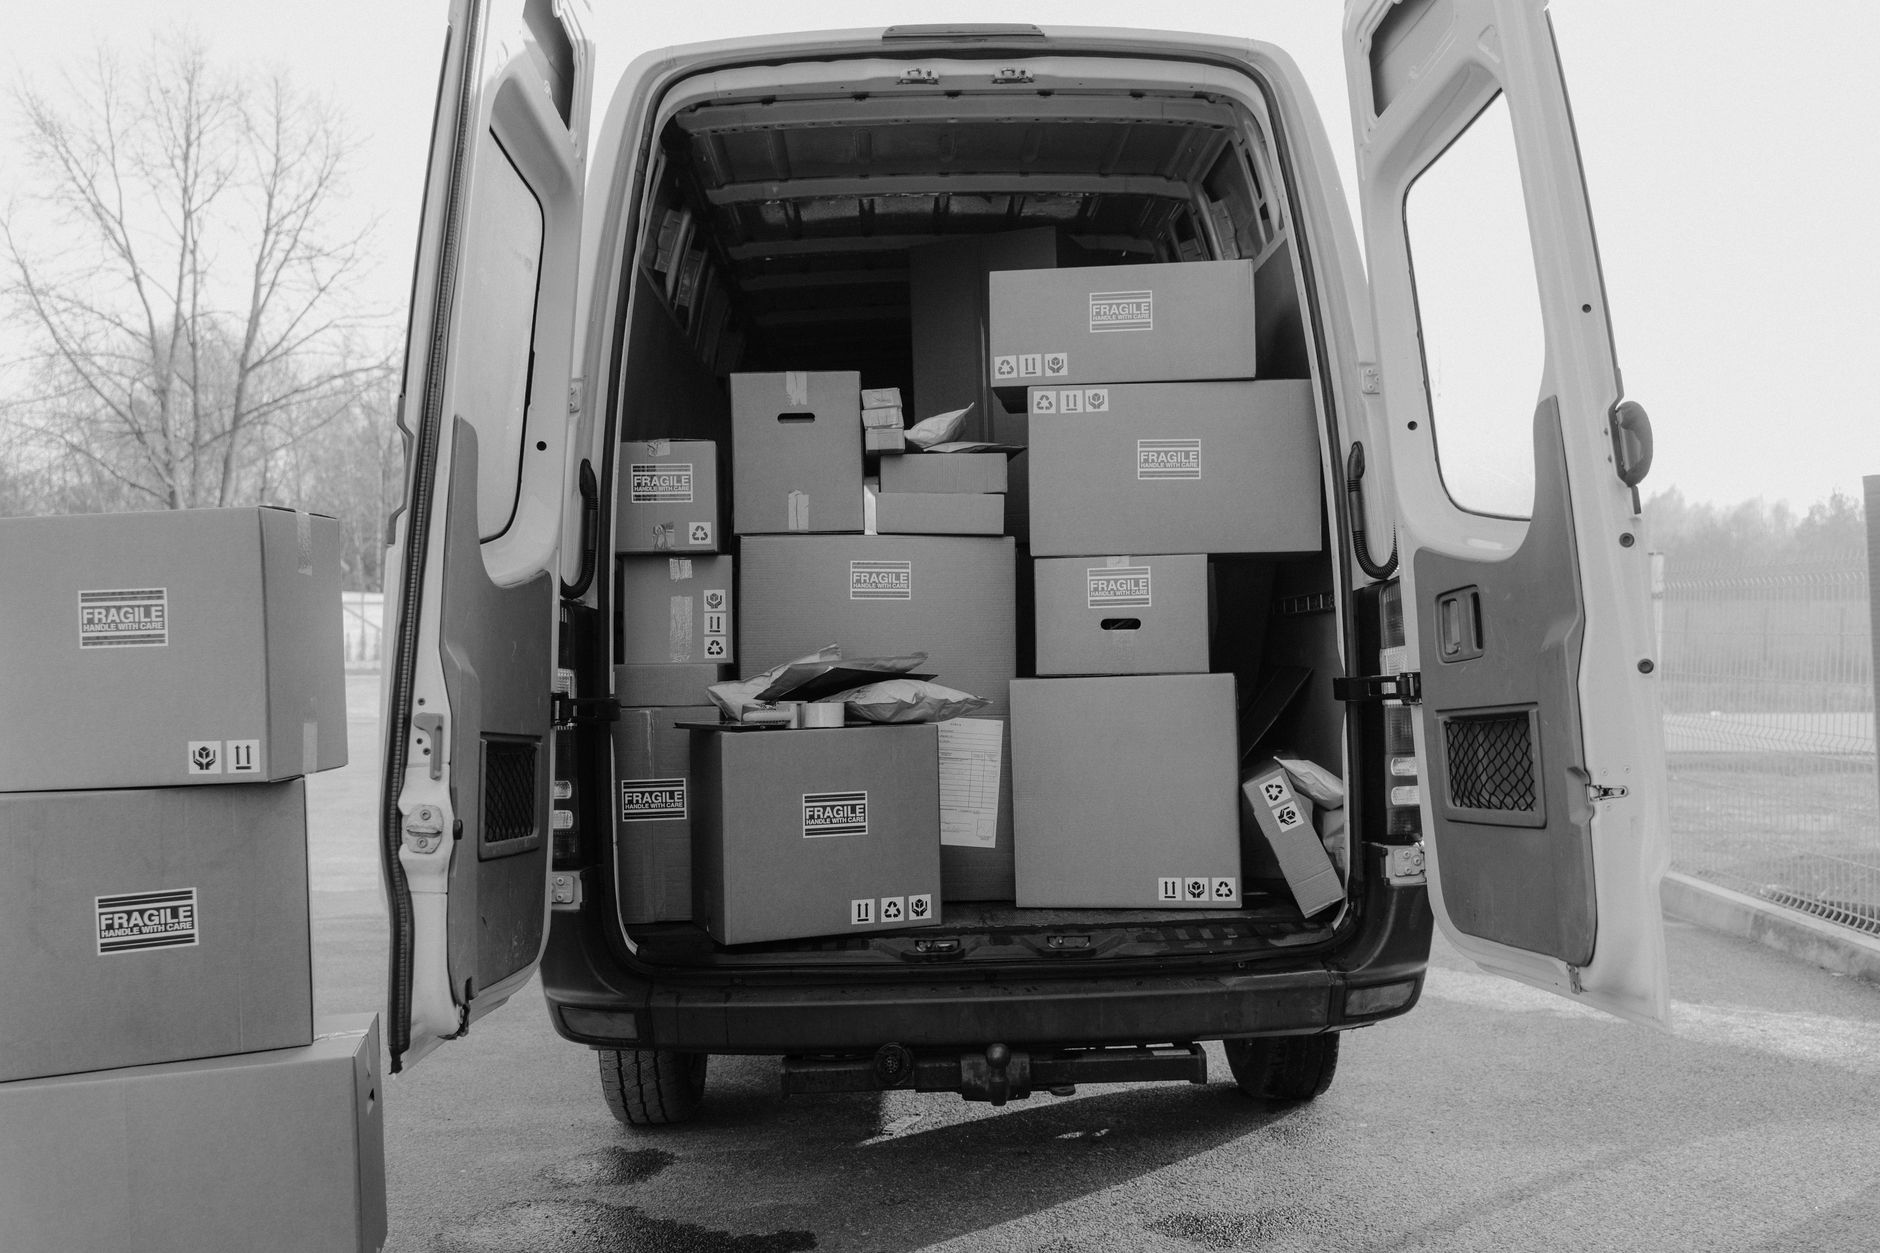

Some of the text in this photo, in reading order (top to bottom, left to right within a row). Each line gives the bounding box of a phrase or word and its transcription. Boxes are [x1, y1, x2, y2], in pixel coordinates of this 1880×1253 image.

[1092, 304, 1149, 315] FRAGILE
[1141, 452, 1198, 462] FRAGILE
[634, 476, 689, 486] FRAGILE
[853, 573, 908, 584] FRAGILE
[1090, 579, 1147, 591] FRAGILE
[83, 606, 163, 623] FRAGILE
[83, 623, 117, 632] HANDLE
[140, 621, 164, 630] CARE
[625, 792, 683, 803] FRAGILE
[806, 805, 864, 819] FRAGILE
[100, 906, 192, 930] FRAGILE
[101, 922, 192, 937] HANDLE WITH CARE
